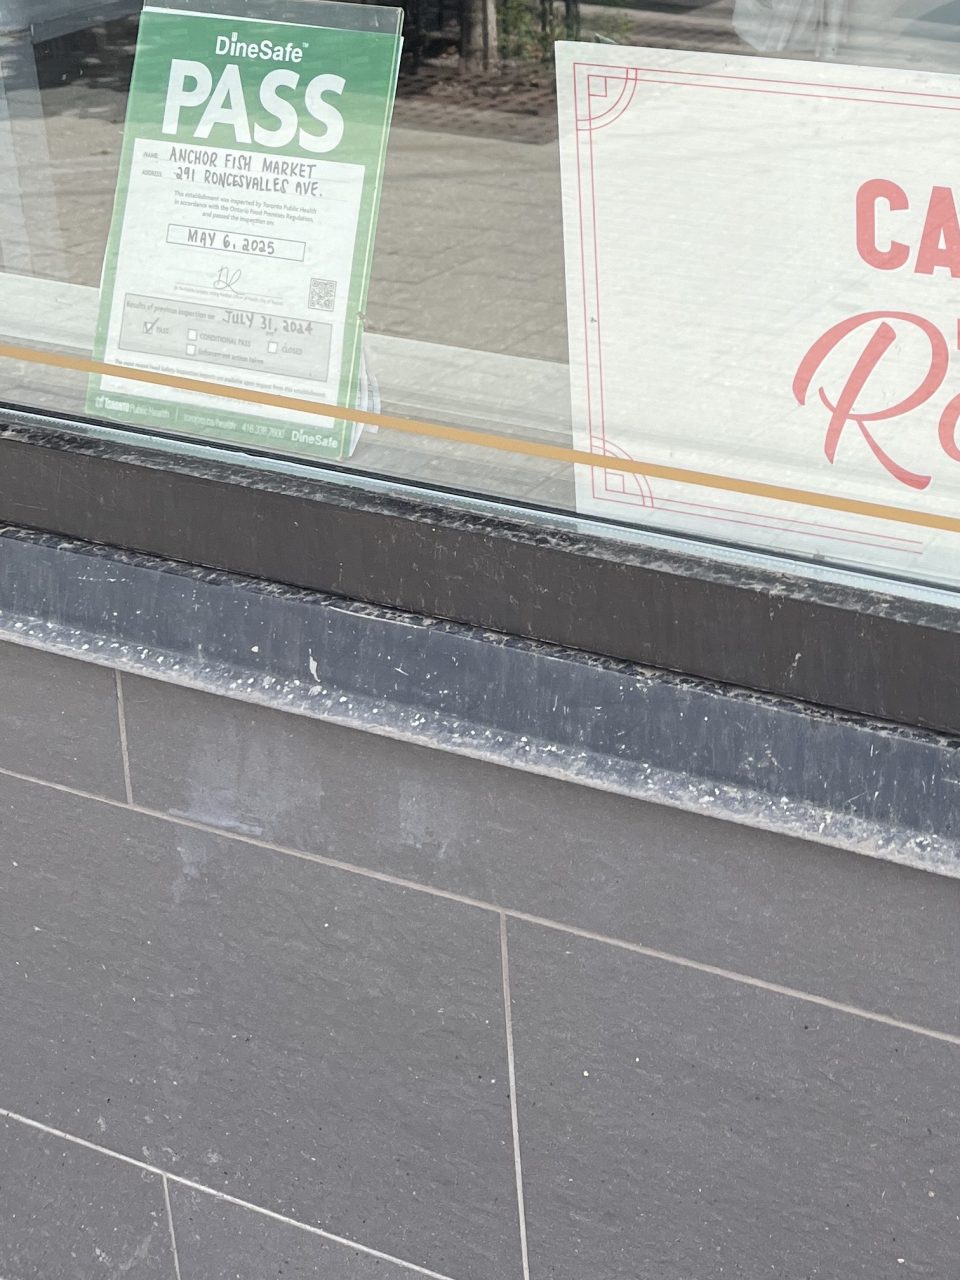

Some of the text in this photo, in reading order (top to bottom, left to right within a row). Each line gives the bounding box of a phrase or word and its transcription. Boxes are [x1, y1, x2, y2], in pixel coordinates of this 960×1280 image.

[162, 58, 346, 154] PASS
[169, 146, 218, 168] ANCHOR
[225, 154, 253, 172] FISH
[262, 157, 317, 179] MARKET
[176, 166, 195, 183] 291
[204, 170, 289, 194] RONCESVALLES
[295, 181, 323, 197] AVE.
[188, 228, 216, 247] MAY
[241, 238, 275, 255] 2025
[222, 310, 255, 328] JULY
[283, 319, 314, 336] 2024
[291, 429, 338, 448] DineSafe
